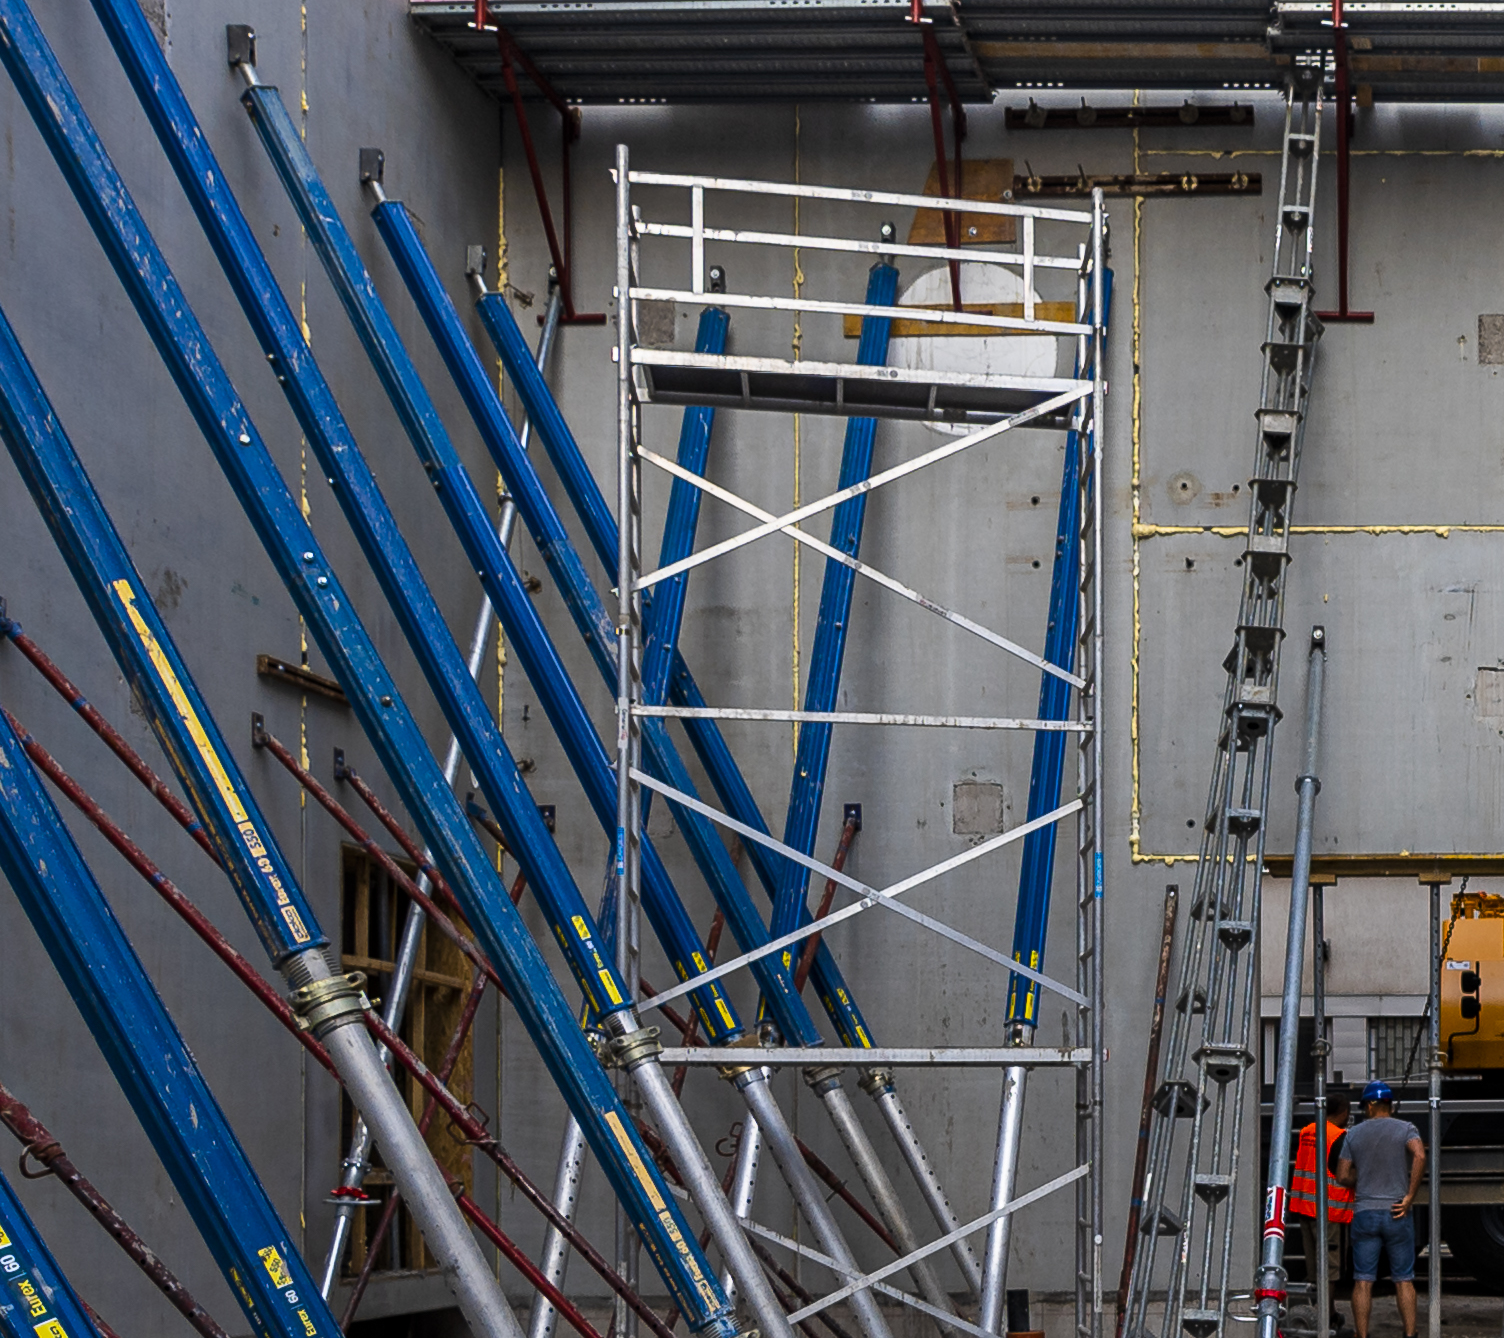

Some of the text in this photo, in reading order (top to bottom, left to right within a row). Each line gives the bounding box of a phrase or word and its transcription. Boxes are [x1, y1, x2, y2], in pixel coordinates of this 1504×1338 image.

[242, 827, 263, 850] 550
[0, 1254, 20, 1273] 60
[17, 1279, 47, 1318] Eurex
[284, 1289, 299, 1304] 60
[297, 1309, 318, 1337] Eurex
